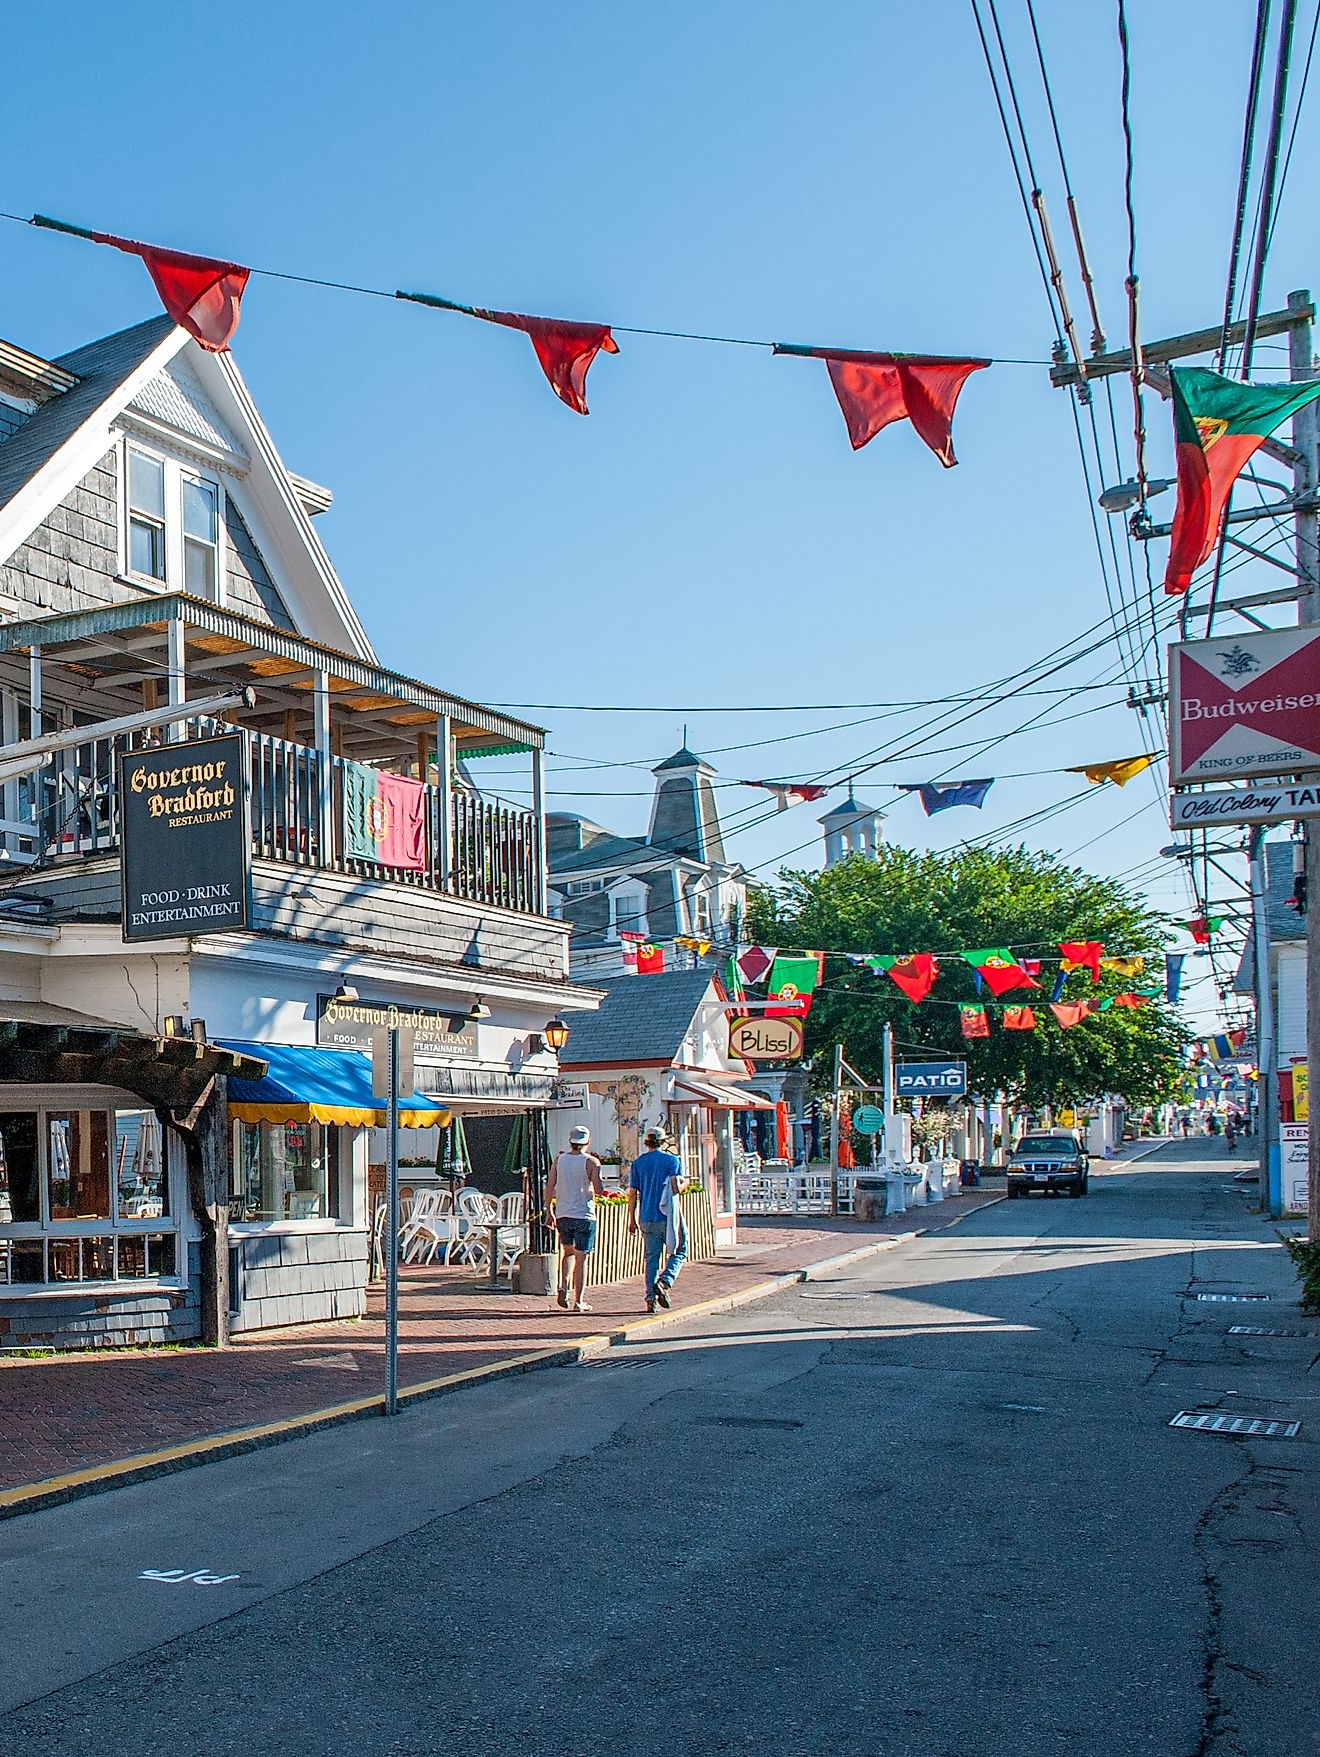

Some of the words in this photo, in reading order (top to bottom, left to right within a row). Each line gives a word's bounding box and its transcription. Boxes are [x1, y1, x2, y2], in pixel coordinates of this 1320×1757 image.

[1199, 758, 1232, 769] KING
[1236, 755, 1255, 766] OF
[131, 760, 226, 794] Governor
[148, 780, 235, 818] Bradford
[1182, 796, 1221, 819] Old
[1220, 793, 1282, 814] Colony
[168, 810, 233, 828] RESTAURANT
[141, 889, 180, 906] FOOD
[186, 883, 231, 901] DRINK
[132, 901, 241, 926] ENTERTAINMENT
[325, 999, 387, 1024] Governor
[387, 1004, 442, 1031] Bradford
[333, 1034, 357, 1044] FOOD
[414, 1031, 474, 1046] ESTAURANT
[414, 1042, 467, 1055] TERTAINMENT
[899, 1074, 962, 1087] PATIO
[1286, 1129, 1309, 1137] REN
